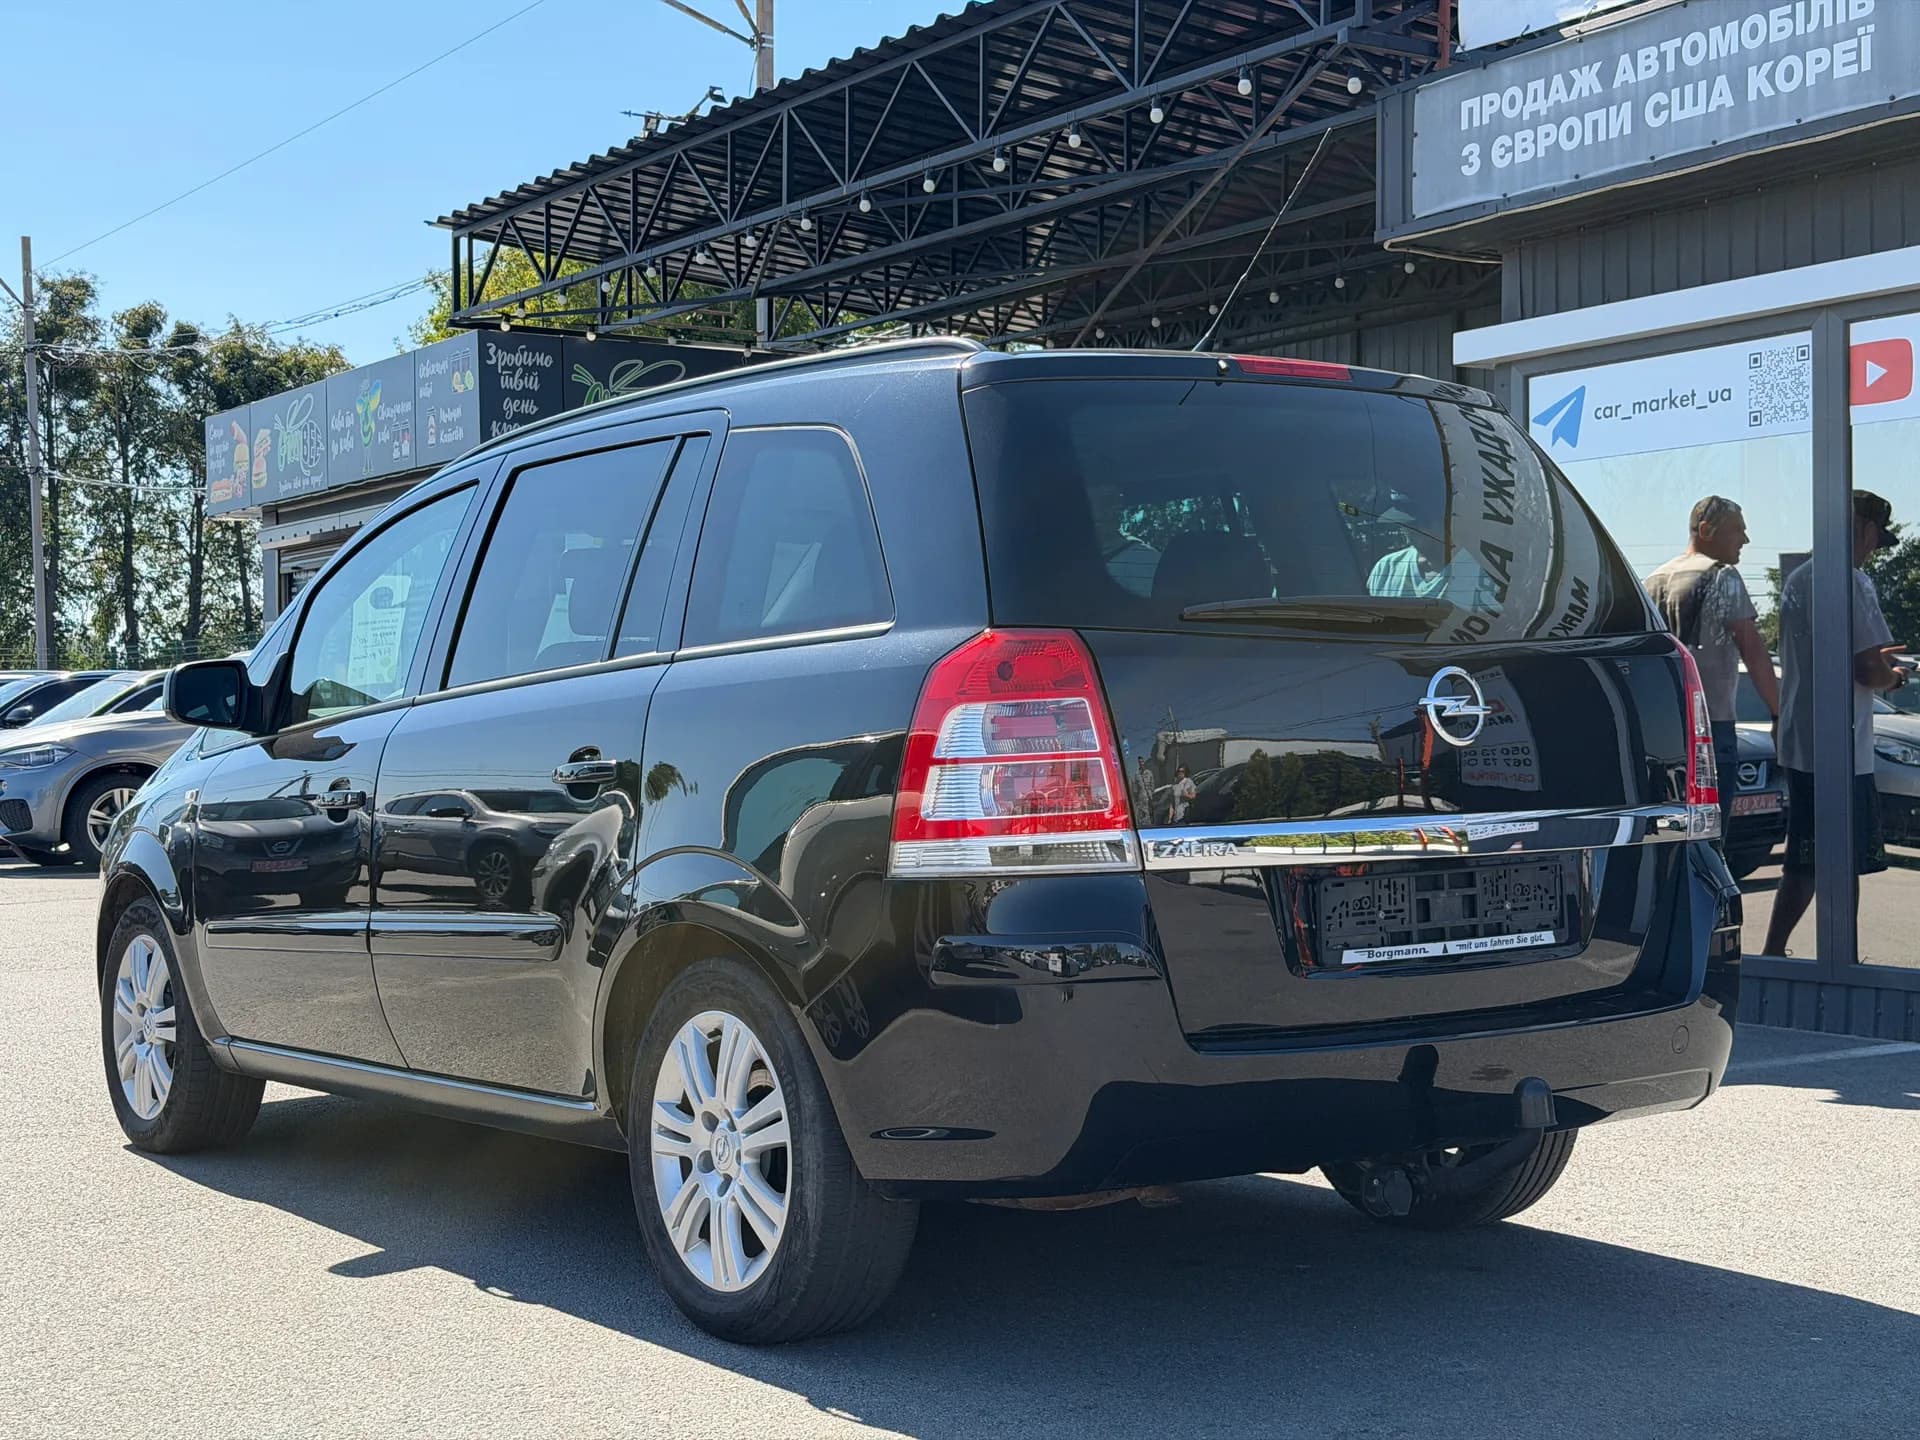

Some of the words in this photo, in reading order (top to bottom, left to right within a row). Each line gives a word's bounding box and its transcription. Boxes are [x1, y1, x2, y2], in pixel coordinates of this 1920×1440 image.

[1461, 61, 1603, 131] ПРОДАЖ
[1461, 143, 1481, 176] З
[1491, 101, 1632, 169] ЄВРОПИ
[1644, 75, 1735, 128] США
[1747, 24, 1875, 102] КОРЕЇ
[486, 343, 554, 373] Зробимо
[501, 367, 540, 391] твій
[503, 397, 539, 420] день
[1594, 386, 1732, 421] car_market_ua
[1159, 842, 1239, 858] ZAFIRA
[1474, 941, 1488, 950] uns
[1490, 936, 1514, 947] fahren
[1516, 935, 1529, 944] Sie
